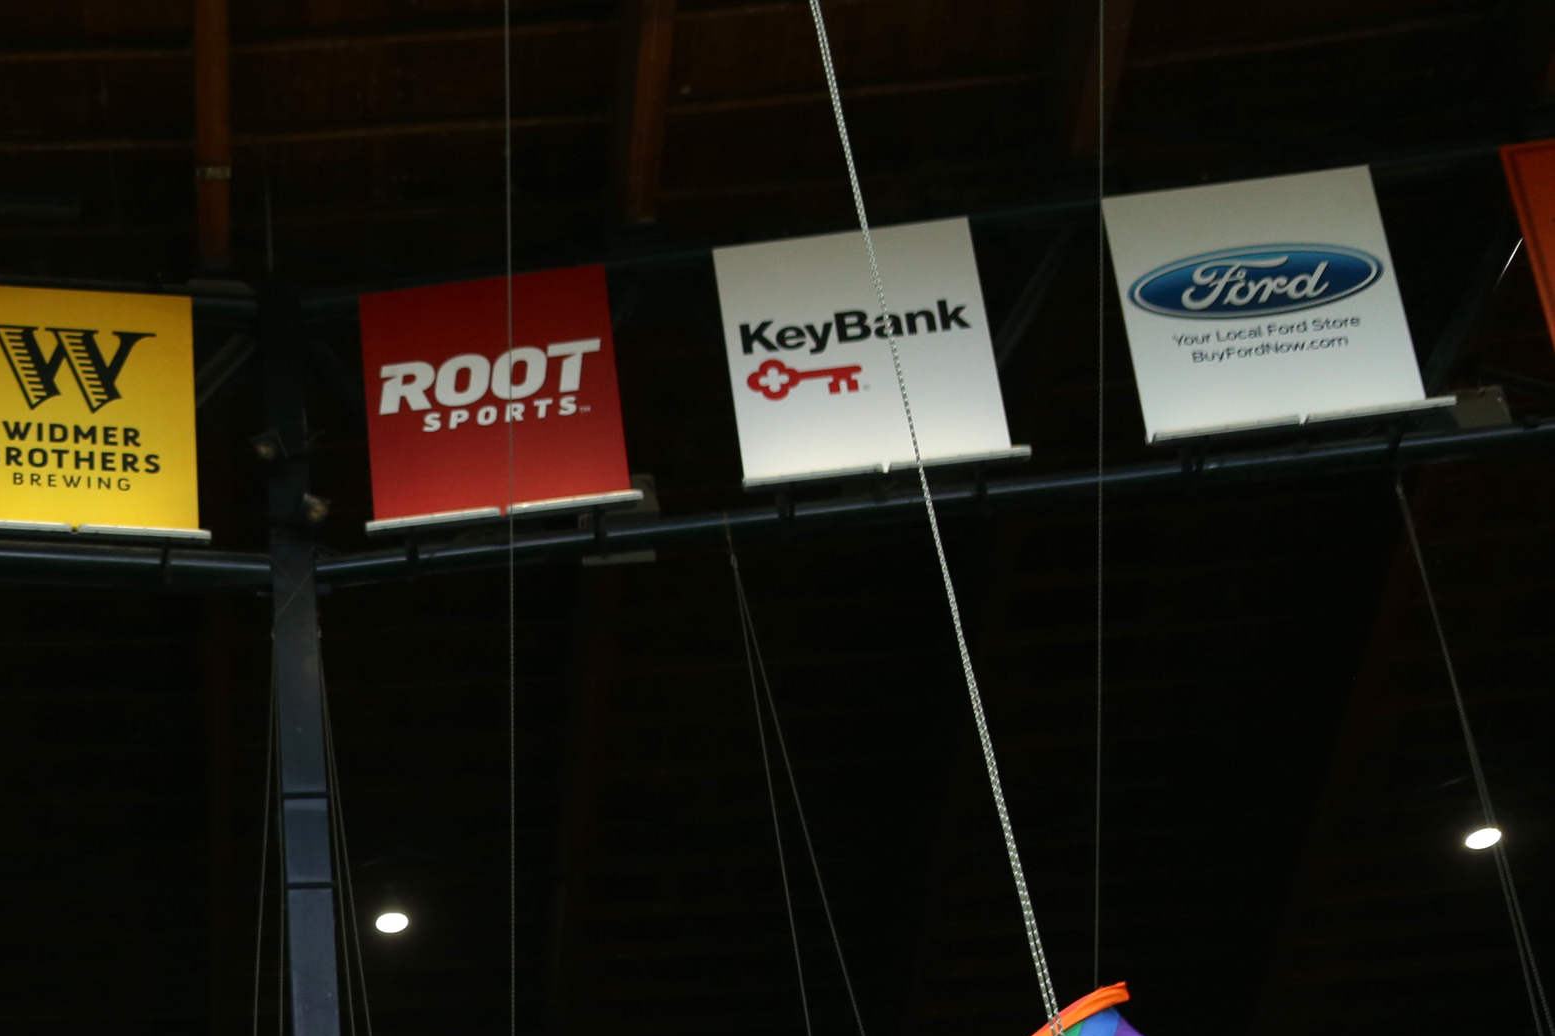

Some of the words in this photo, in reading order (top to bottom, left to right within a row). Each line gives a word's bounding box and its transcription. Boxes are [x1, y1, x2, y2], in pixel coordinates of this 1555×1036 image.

[1181, 254, 1330, 311] Ford
[738, 299, 971, 356] KeyBank
[1173, 332, 1211, 348] Your
[1215, 325, 1263, 343] Local
[1267, 319, 1308, 337] Ford
[1311, 314, 1361, 332] Store
[1191, 336, 1350, 364] BuyFordNow.com
[379, 337, 601, 416] ROOT
[422, 395, 578, 433] SPORTS
[1, 420, 142, 448] WIDMER
[12, 472, 133, 491] BREWING
